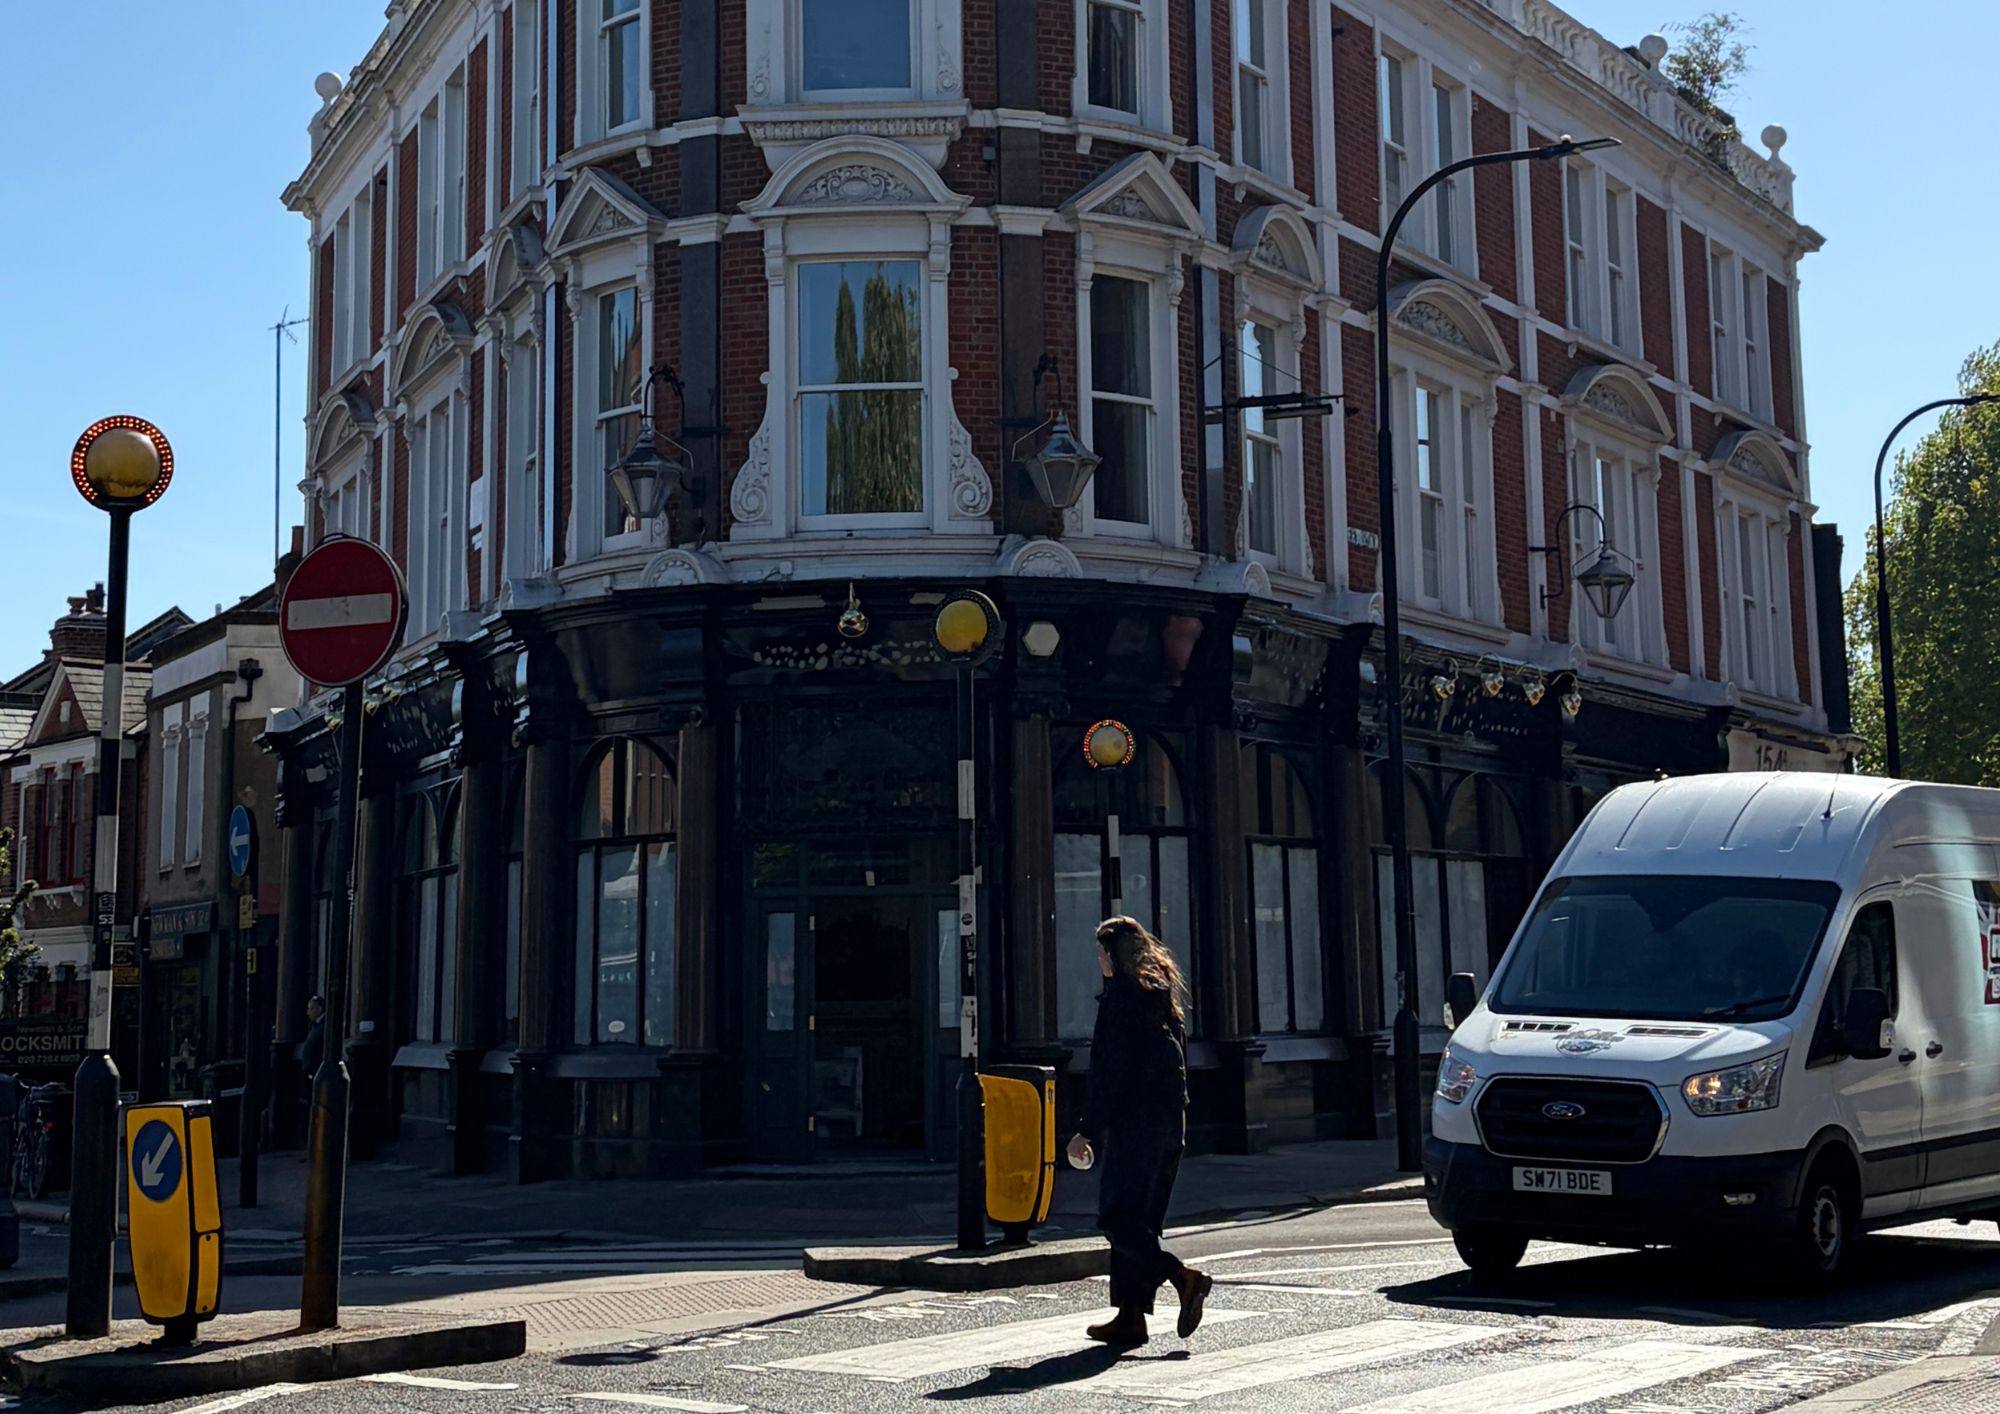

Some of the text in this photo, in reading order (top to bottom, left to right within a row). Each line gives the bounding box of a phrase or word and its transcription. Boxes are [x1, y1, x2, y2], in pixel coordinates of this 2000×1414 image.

[0, 1034, 88, 1052] OCKSMIT
[1523, 1169, 1601, 1190] SW71 BDE
